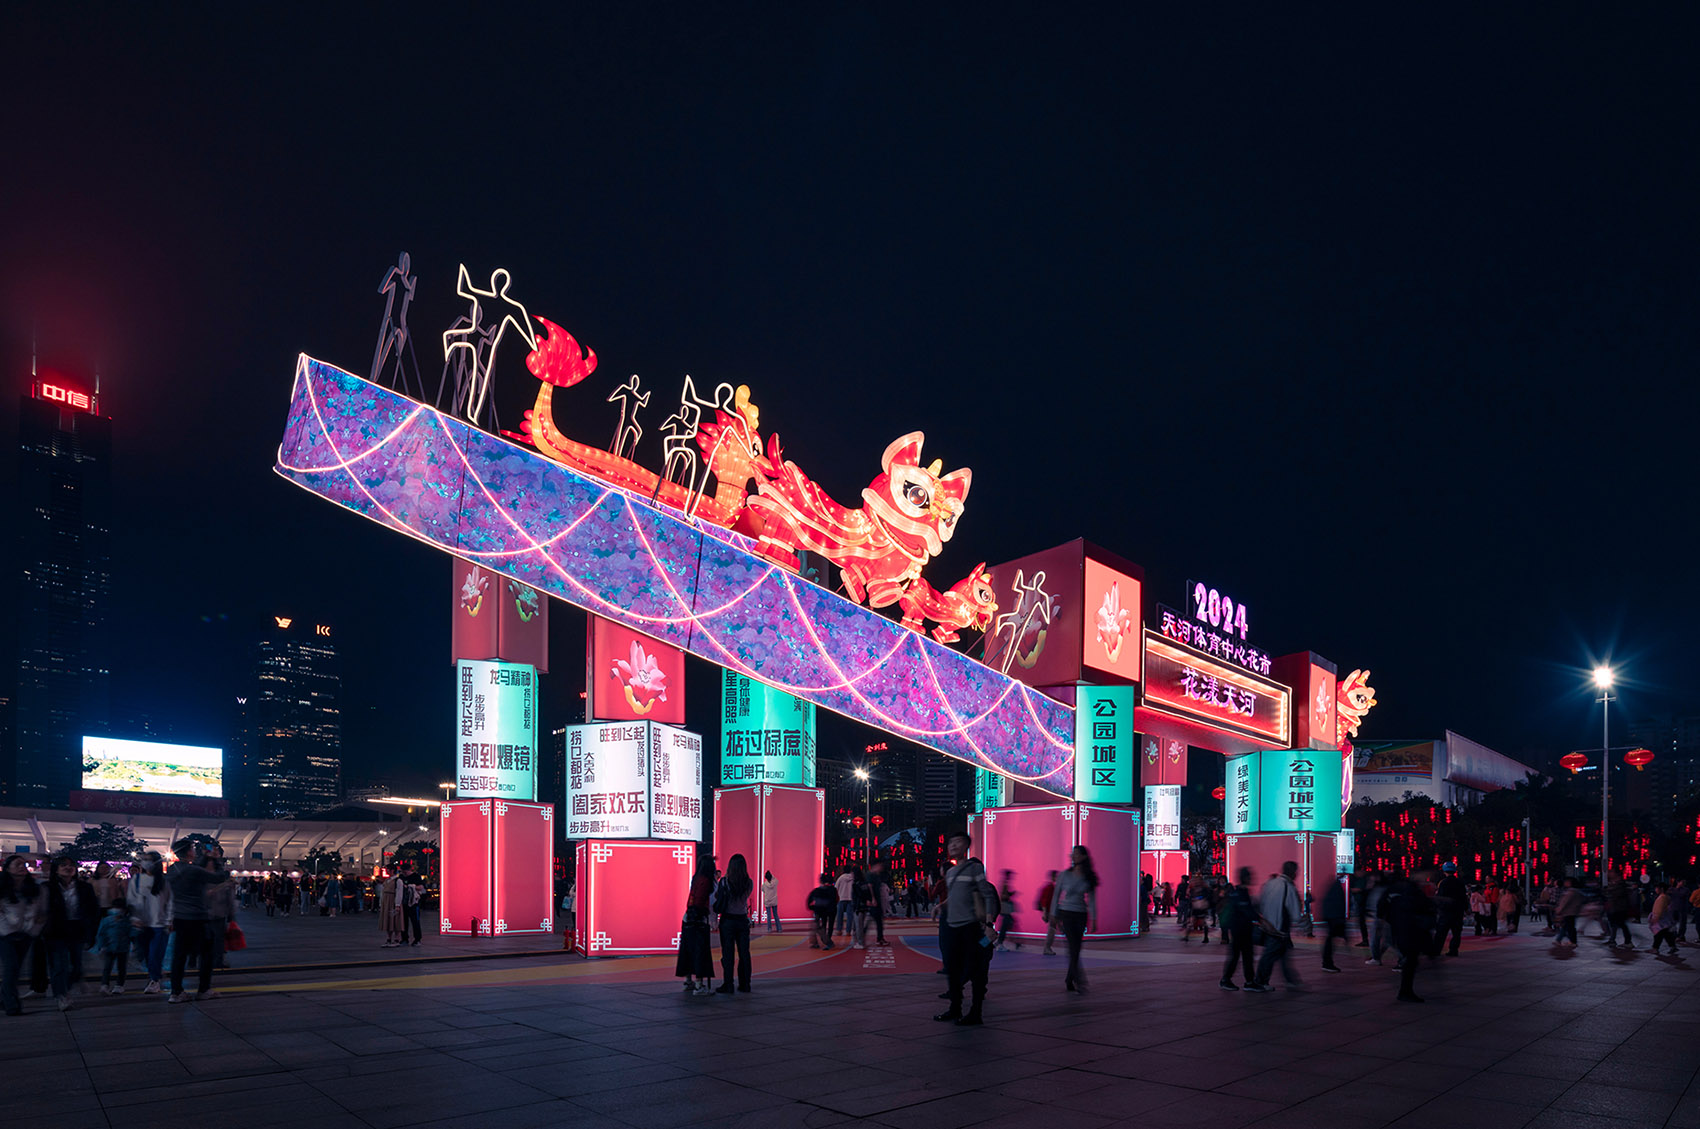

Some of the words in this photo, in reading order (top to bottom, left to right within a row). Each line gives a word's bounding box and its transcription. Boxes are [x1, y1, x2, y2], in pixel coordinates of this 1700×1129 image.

[43, 383, 88, 409] 中信
[1194, 582, 1247, 640] 2024
[1160, 611, 1272, 675] 天河体育中心花市
[490, 669, 531, 687] 龙马精神
[1180, 667, 1257, 718] 花漾天河
[236, 696, 247, 704] W
[462, 666, 473, 737] 旺到飞起
[474, 694, 485, 730] 步步高升
[599, 726, 645, 742] 旺到飞起
[725, 729, 801, 757] 掂过碌蔗
[1092, 699, 1117, 787] 公园城区
[462, 742, 530, 771] 靓到爆镜
[570, 730, 582, 790] 捞乜都掂
[584, 752, 595, 783] 大吉大利
[652, 727, 662, 788] 旺到飞起
[459, 775, 498, 791] 岁岁平安
[723, 764, 765, 780] 笑口常开
[572, 791, 645, 816] 阖家欢乐
[1237, 764, 1249, 824] 绿美天河
[1288, 759, 1315, 820] 公园城区
[654, 792, 701, 819] 靓到爆镜
[569, 820, 610, 834] 步步高升
